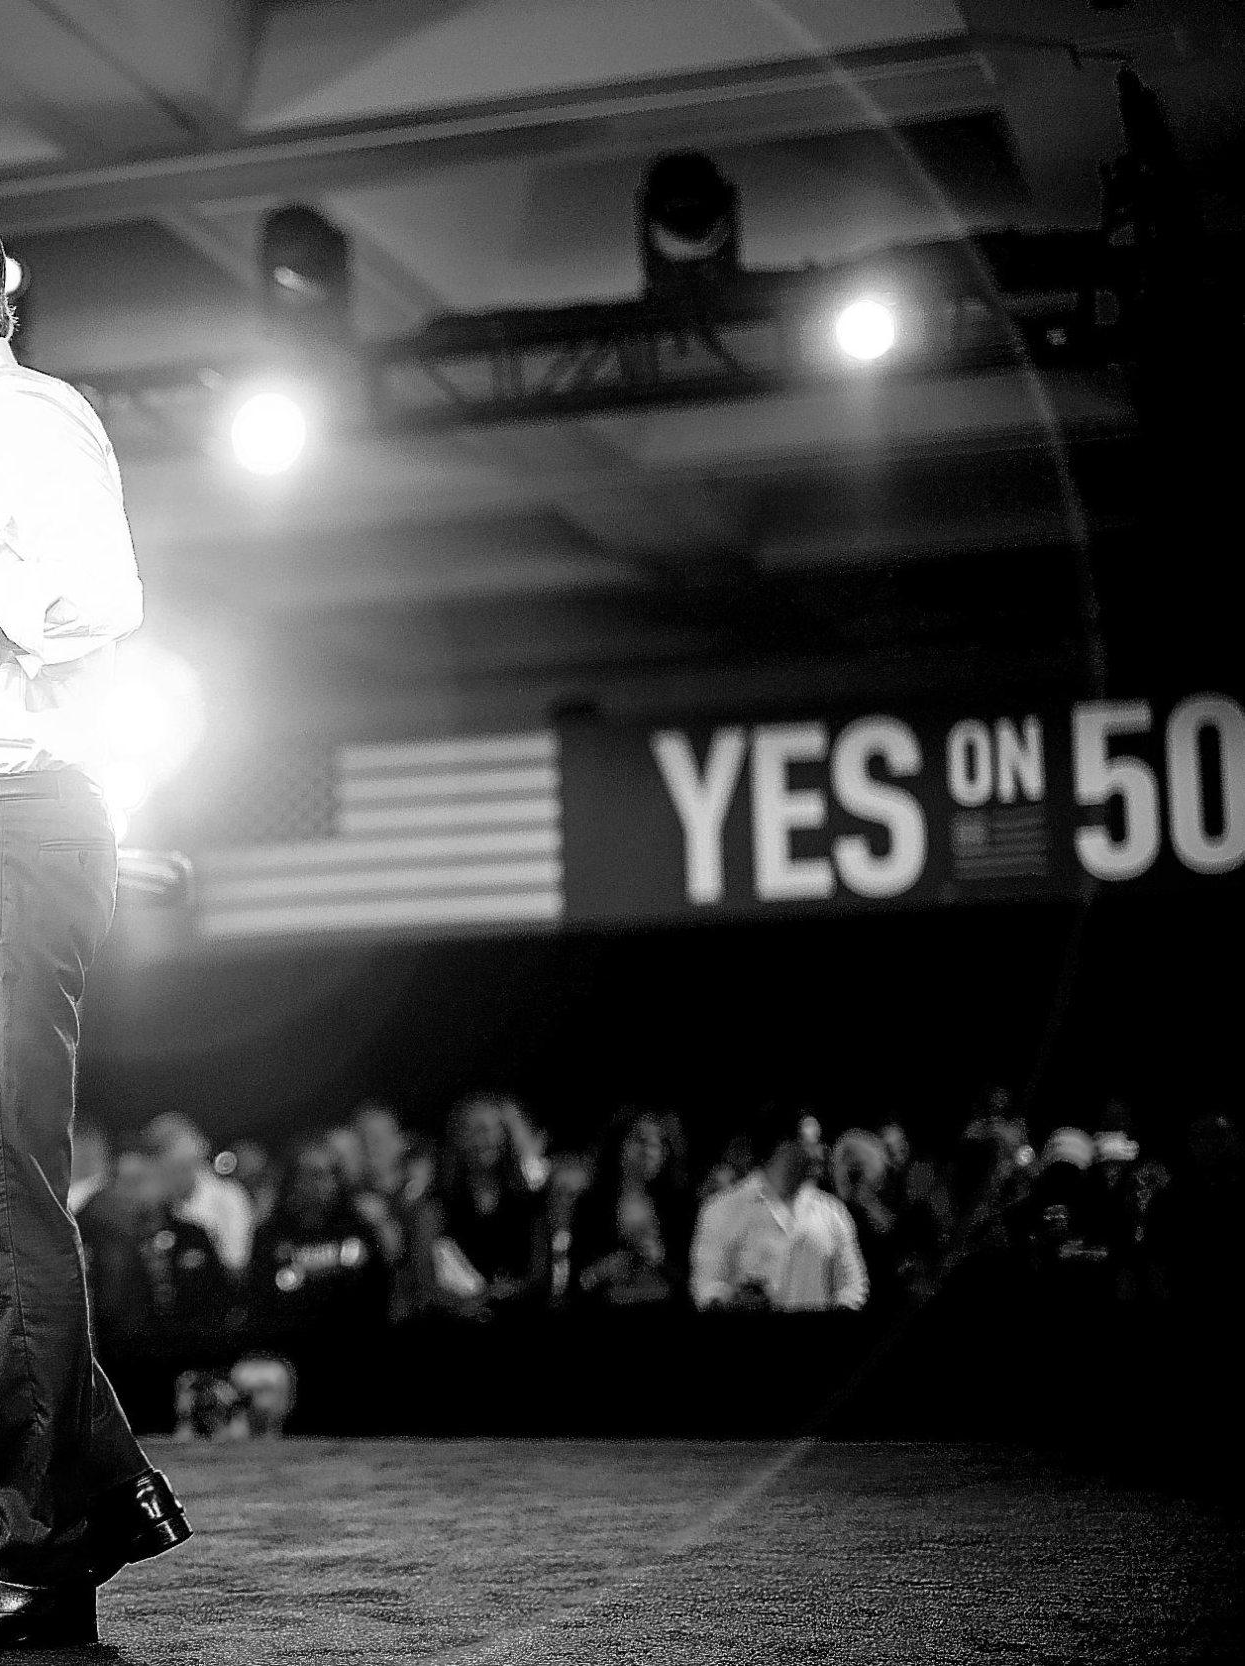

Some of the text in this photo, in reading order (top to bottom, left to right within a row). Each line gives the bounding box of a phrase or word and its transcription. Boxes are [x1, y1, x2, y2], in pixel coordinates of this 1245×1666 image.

[652, 694, 1245, 904] YES ON 50
